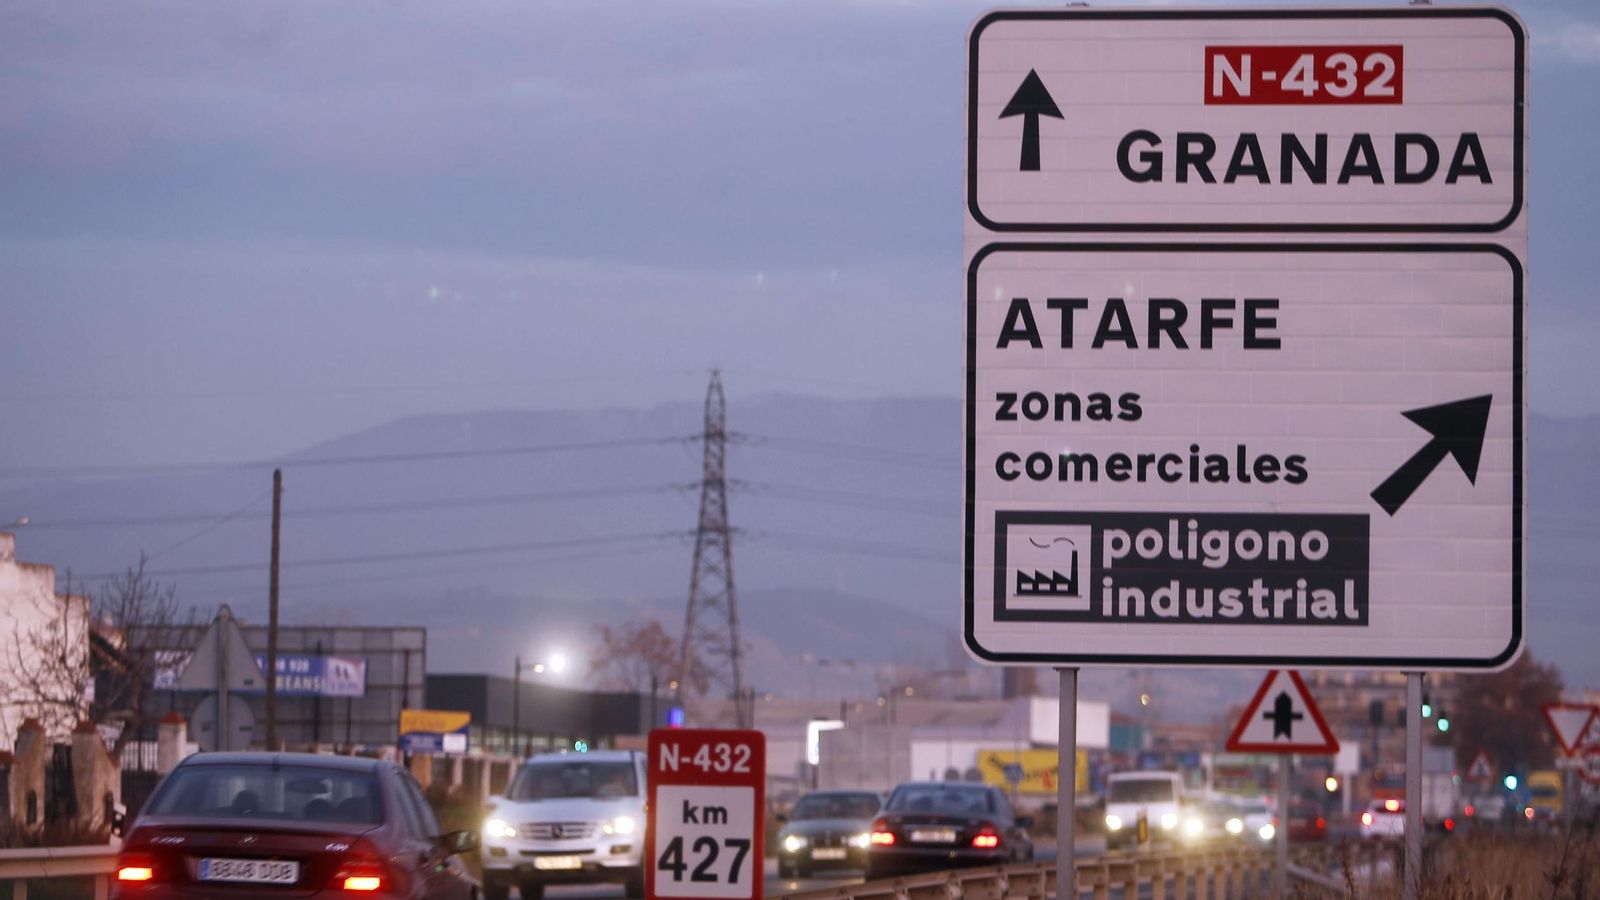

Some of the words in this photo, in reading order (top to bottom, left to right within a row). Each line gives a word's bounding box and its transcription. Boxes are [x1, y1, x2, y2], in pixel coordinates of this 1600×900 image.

[1212, 53, 1396, 97] N-432
[1117, 130, 1492, 184] GRANADA
[996, 298, 1281, 349] ATARFE
[996, 391, 1142, 421] zonas
[996, 444, 1308, 484] comerciales
[1102, 519, 1329, 568] poligono
[1102, 577, 1359, 620] industrial
[659, 743, 751, 772] N-432
[683, 800, 728, 824] km
[658, 836, 751, 884] 427
